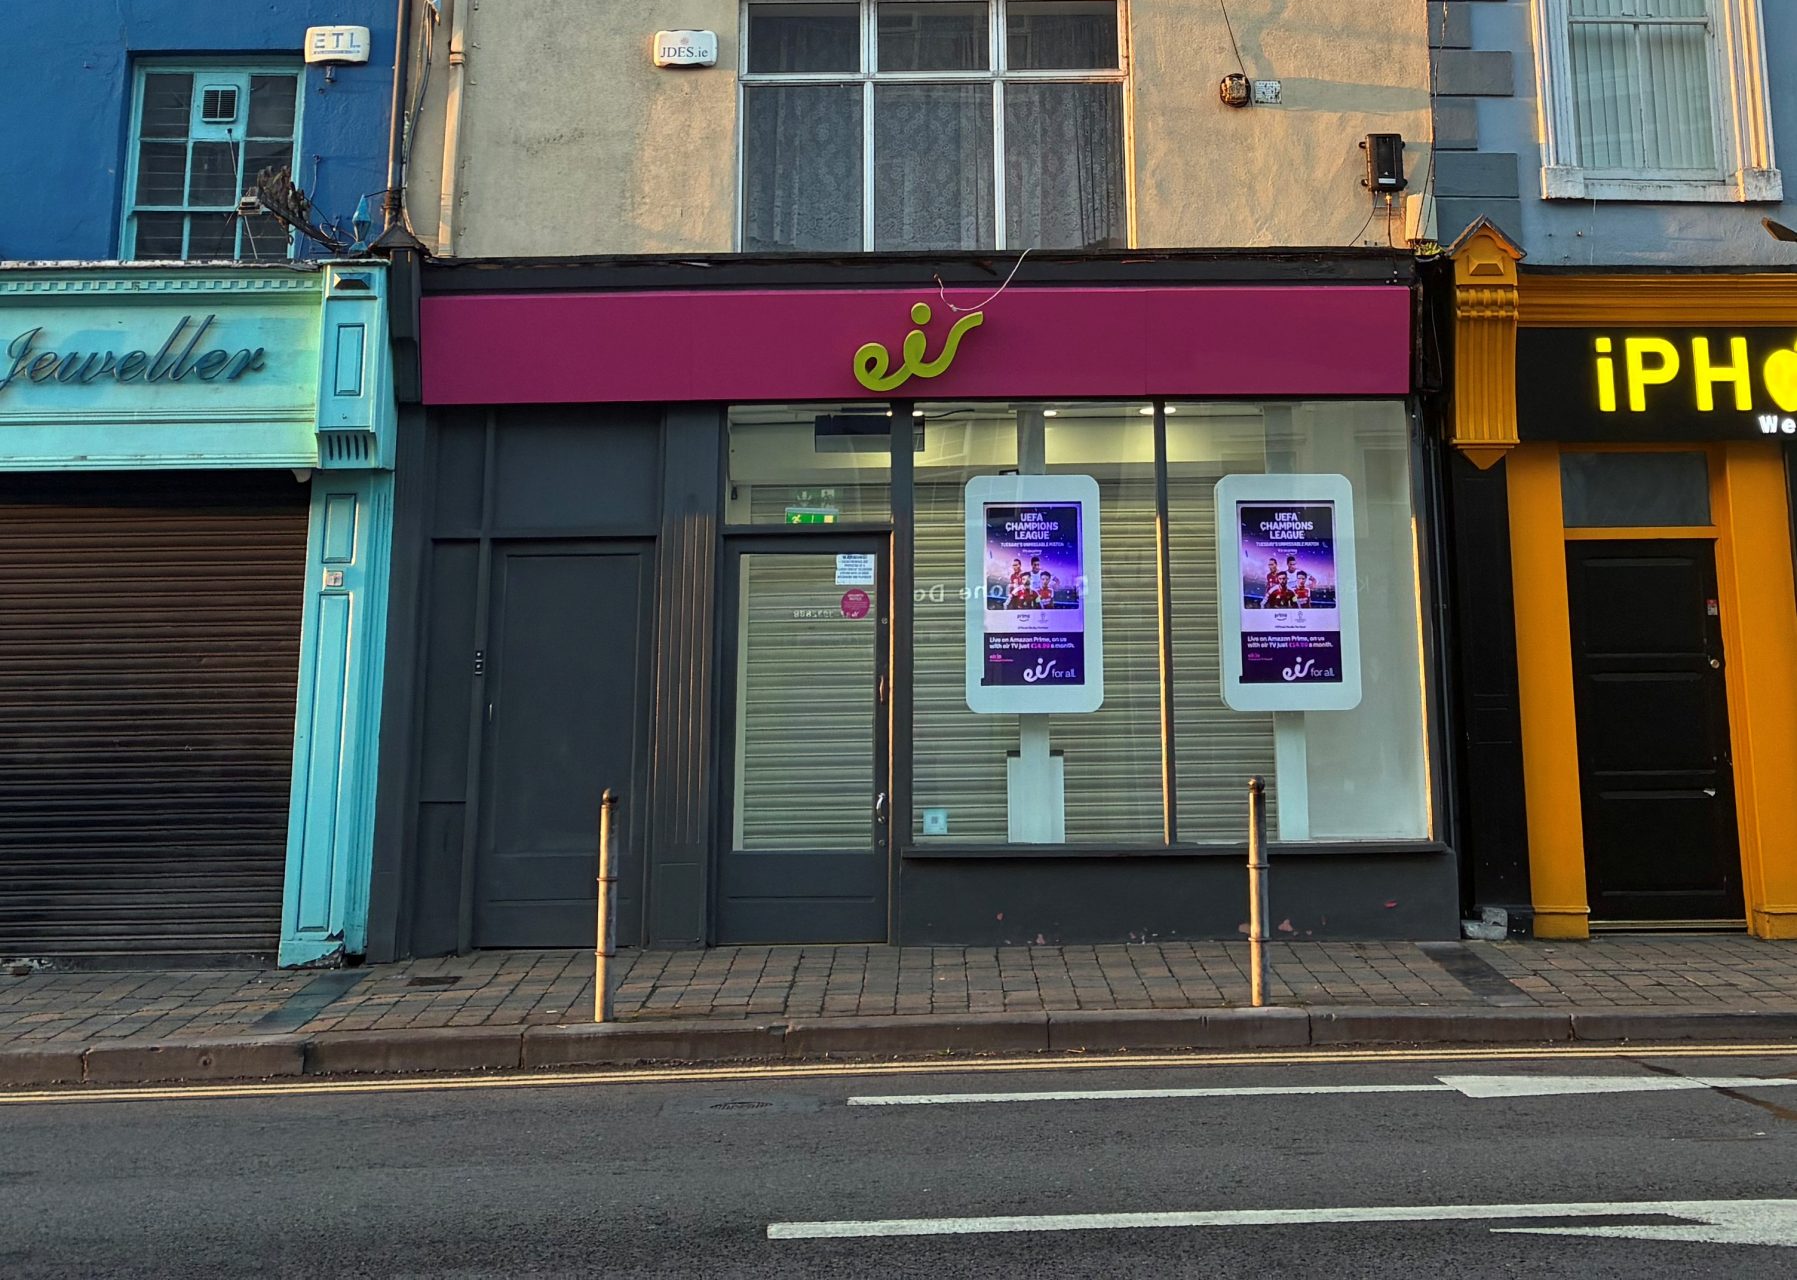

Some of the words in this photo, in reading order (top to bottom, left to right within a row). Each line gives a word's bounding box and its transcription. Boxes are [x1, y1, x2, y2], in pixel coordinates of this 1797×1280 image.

[314, 32, 361, 49] ETL
[660, 46, 708, 58] JDES.ie
[854, 302, 983, 392] eir
[0, 314, 265, 392] Jeweller
[1020, 513, 1043, 521] UEFA
[1275, 513, 1298, 521] UEFA
[1005, 522, 1058, 531] CHAMPIONS
[1260, 522, 1313, 530] CHAMPIONS
[1015, 531, 1050, 539] LEAGUE
[1270, 531, 1305, 539] LEAGUE
[1024, 658, 1056, 682] eir
[1052, 669, 1063, 678] for
[1282, 657, 1315, 681] eir
[1311, 668, 1322, 676] for
